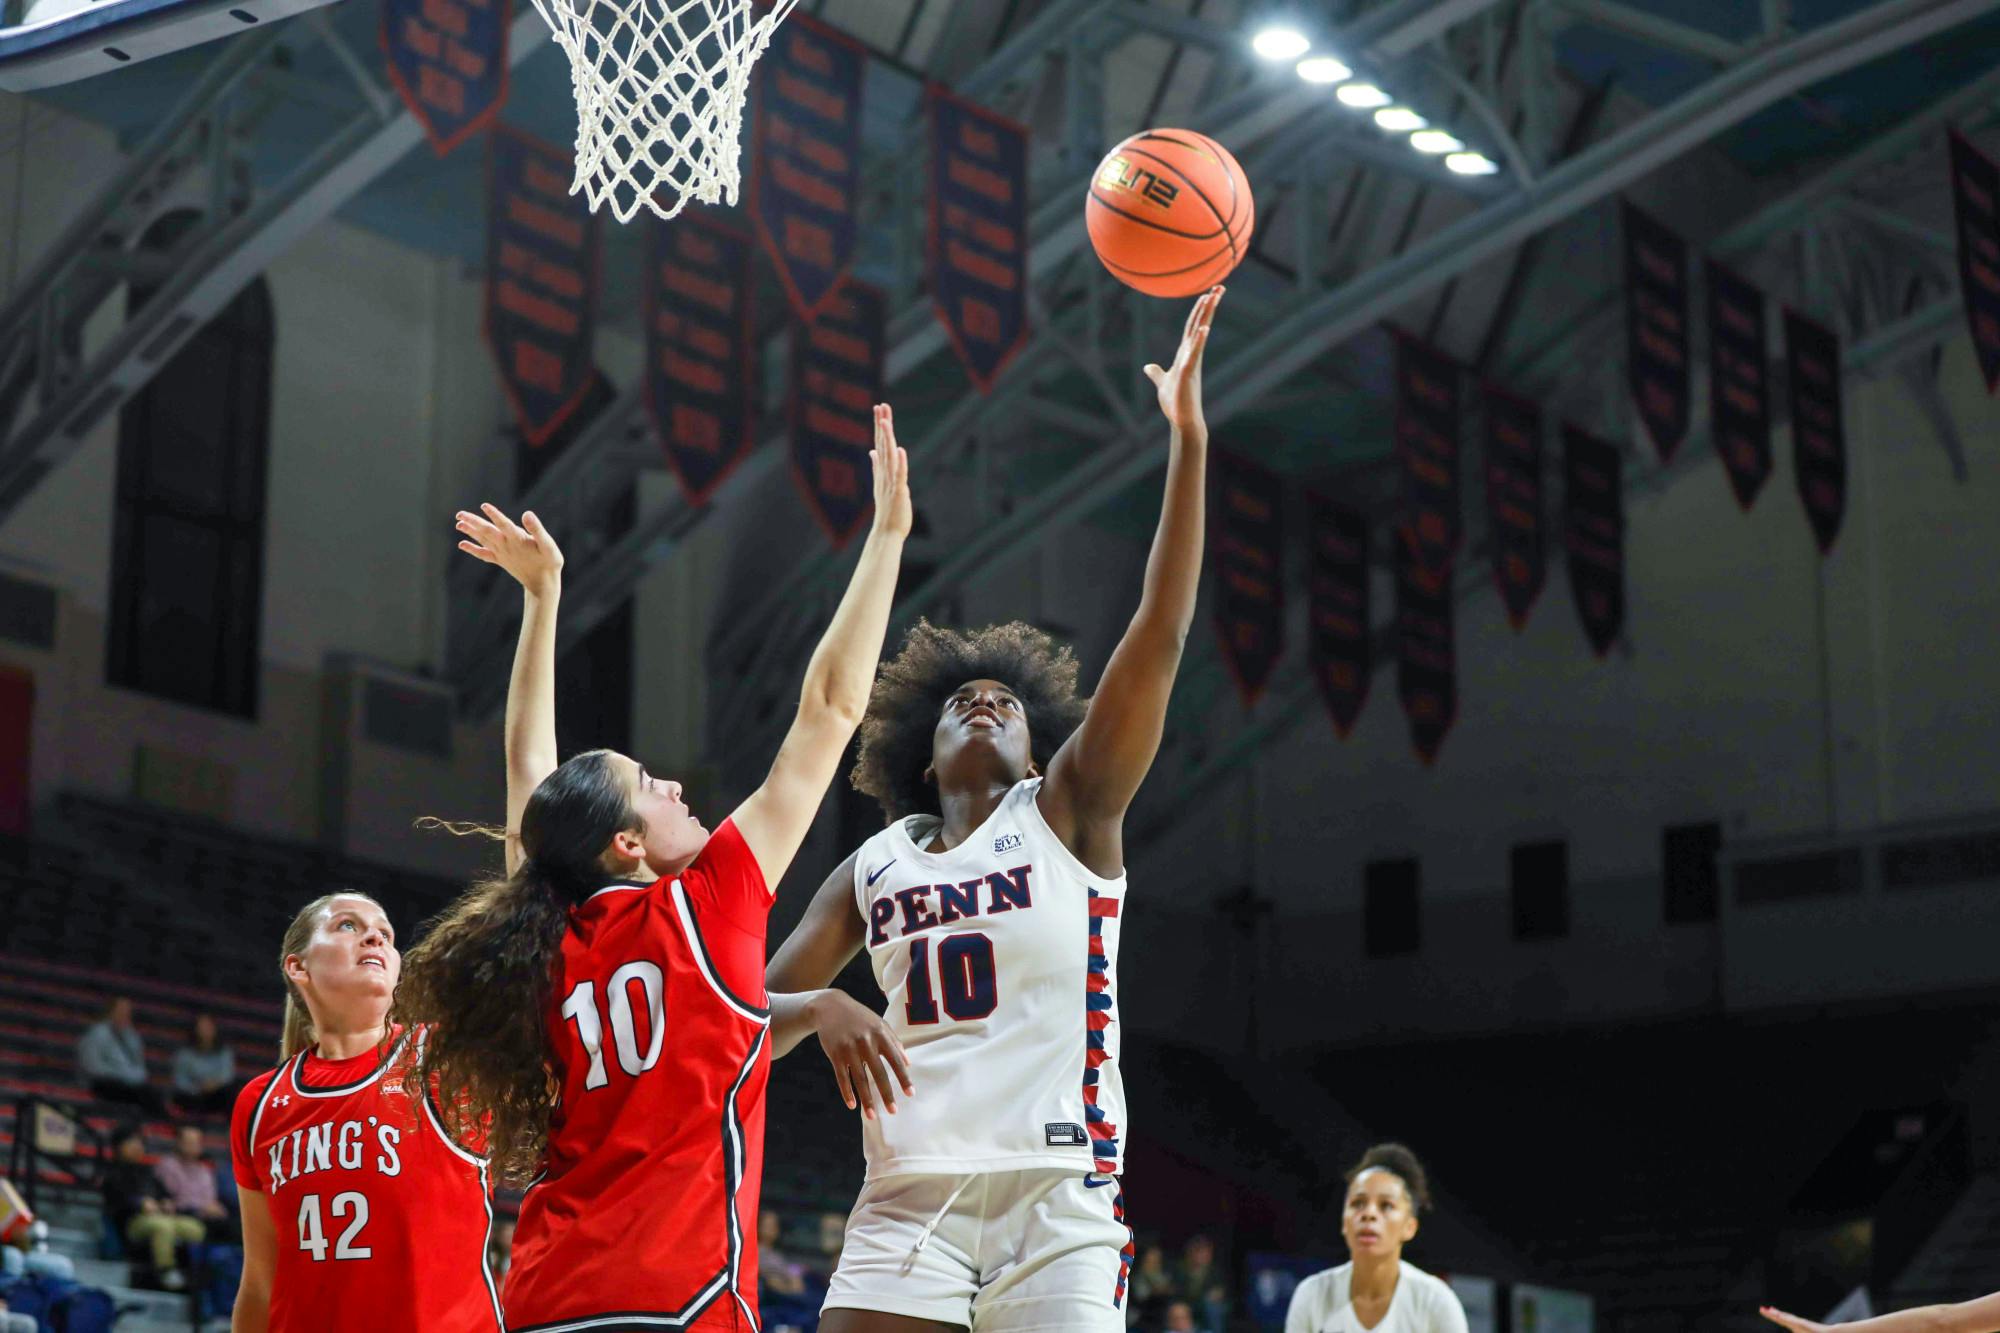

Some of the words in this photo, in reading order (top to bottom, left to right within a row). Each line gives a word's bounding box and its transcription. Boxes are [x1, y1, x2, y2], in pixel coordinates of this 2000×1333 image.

[1001, 833, 1021, 848] IVY
[870, 864, 1032, 948] PENN
[904, 932, 998, 1026] 10
[560, 959, 666, 1091] 10
[268, 1116, 401, 1195] KING'S
[1077, 1129, 1084, 1139] L
[297, 1191, 372, 1261] 42
